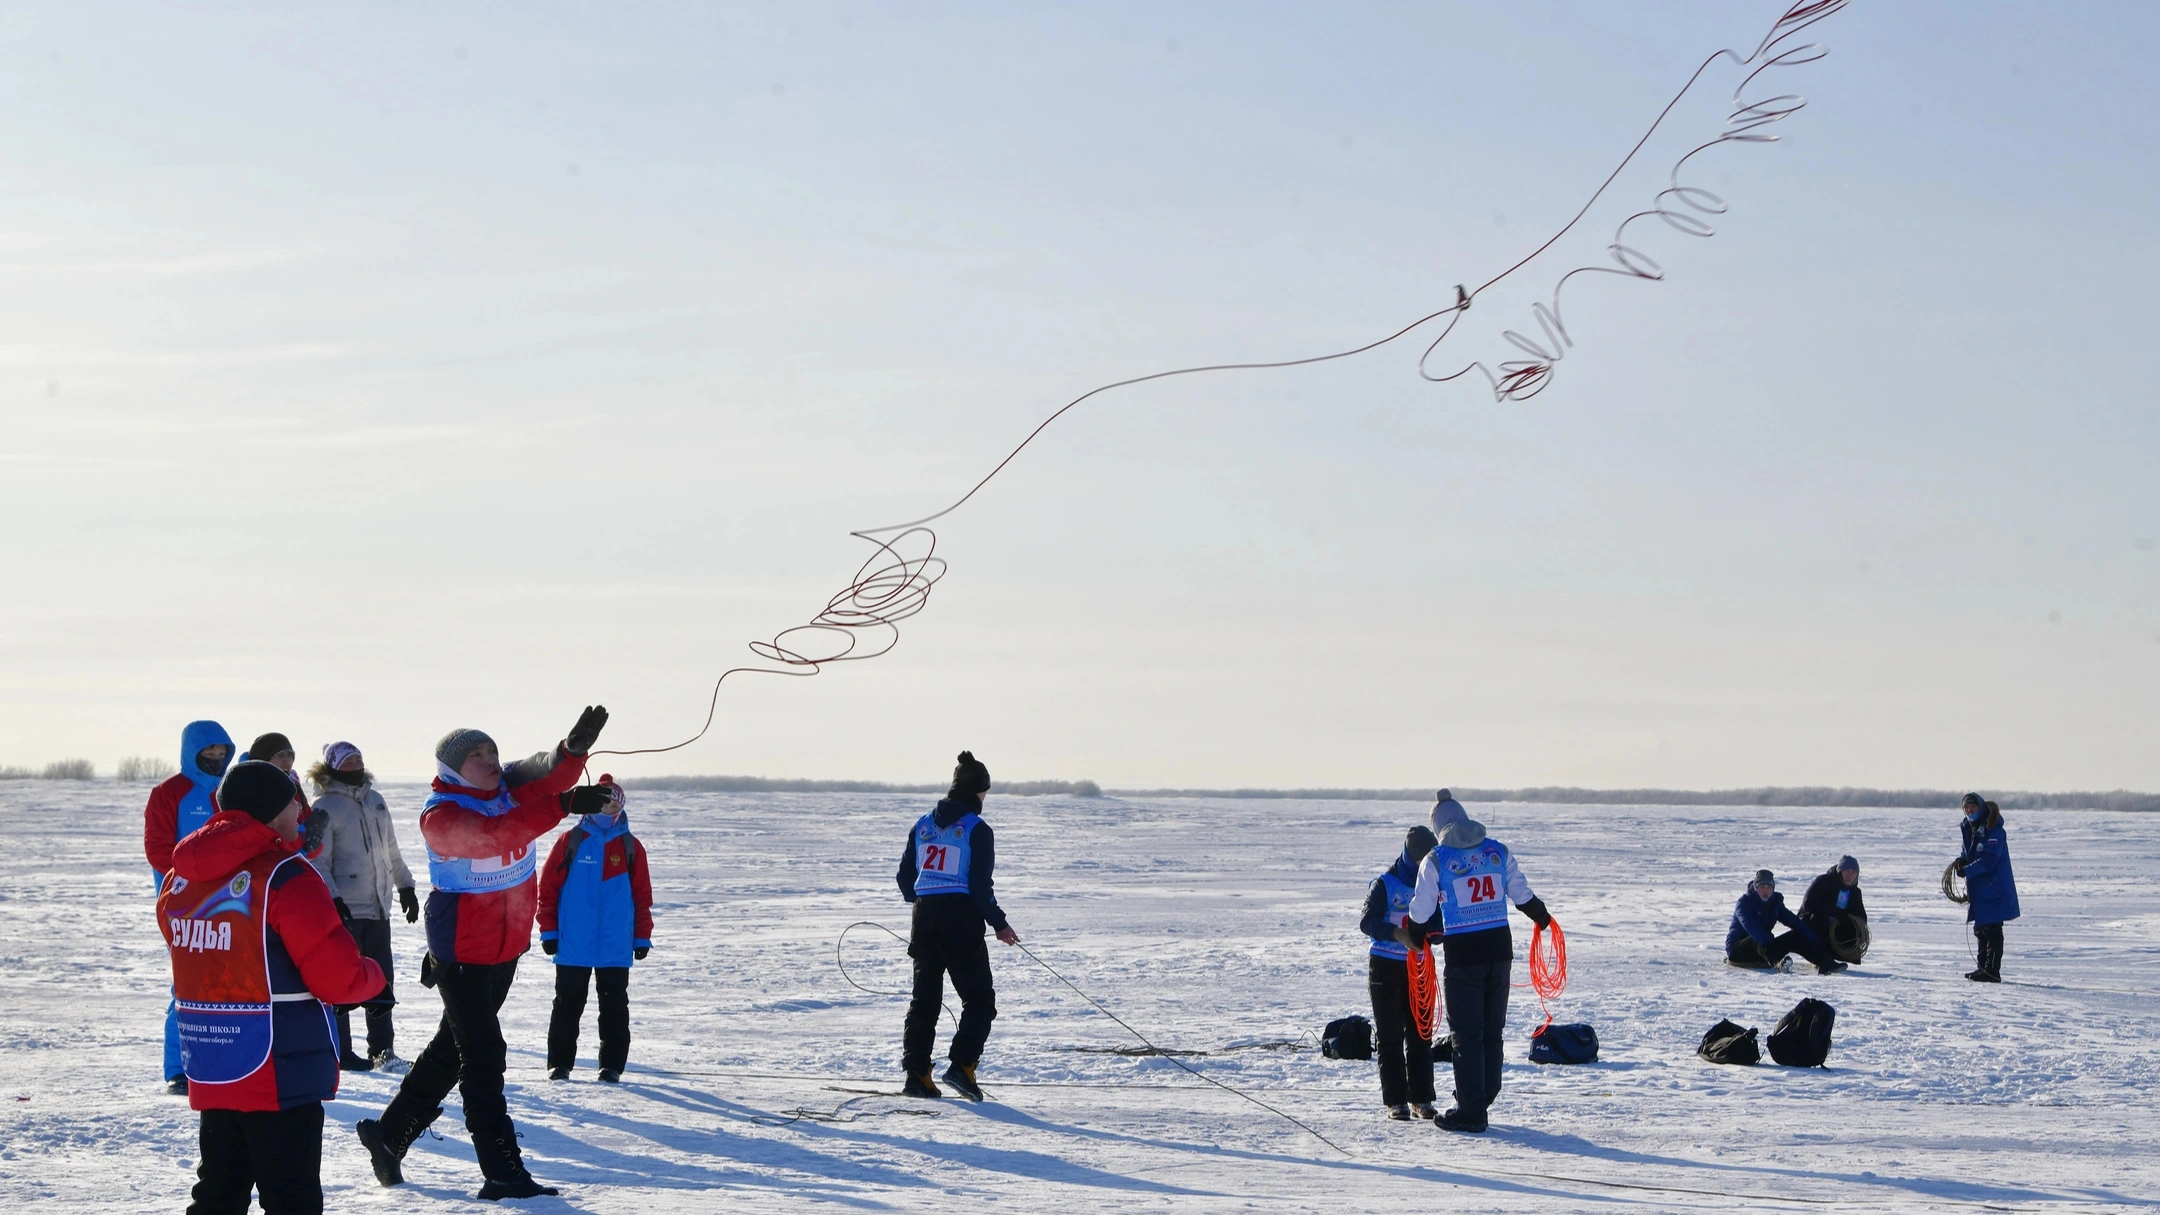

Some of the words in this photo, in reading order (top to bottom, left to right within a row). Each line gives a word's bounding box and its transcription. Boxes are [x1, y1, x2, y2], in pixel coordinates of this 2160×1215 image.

[923, 845, 947, 871] 21
[1467, 876, 1496, 903] 24
[170, 917, 232, 953] СУДЬЯ
[209, 1025, 241, 1034] школа
